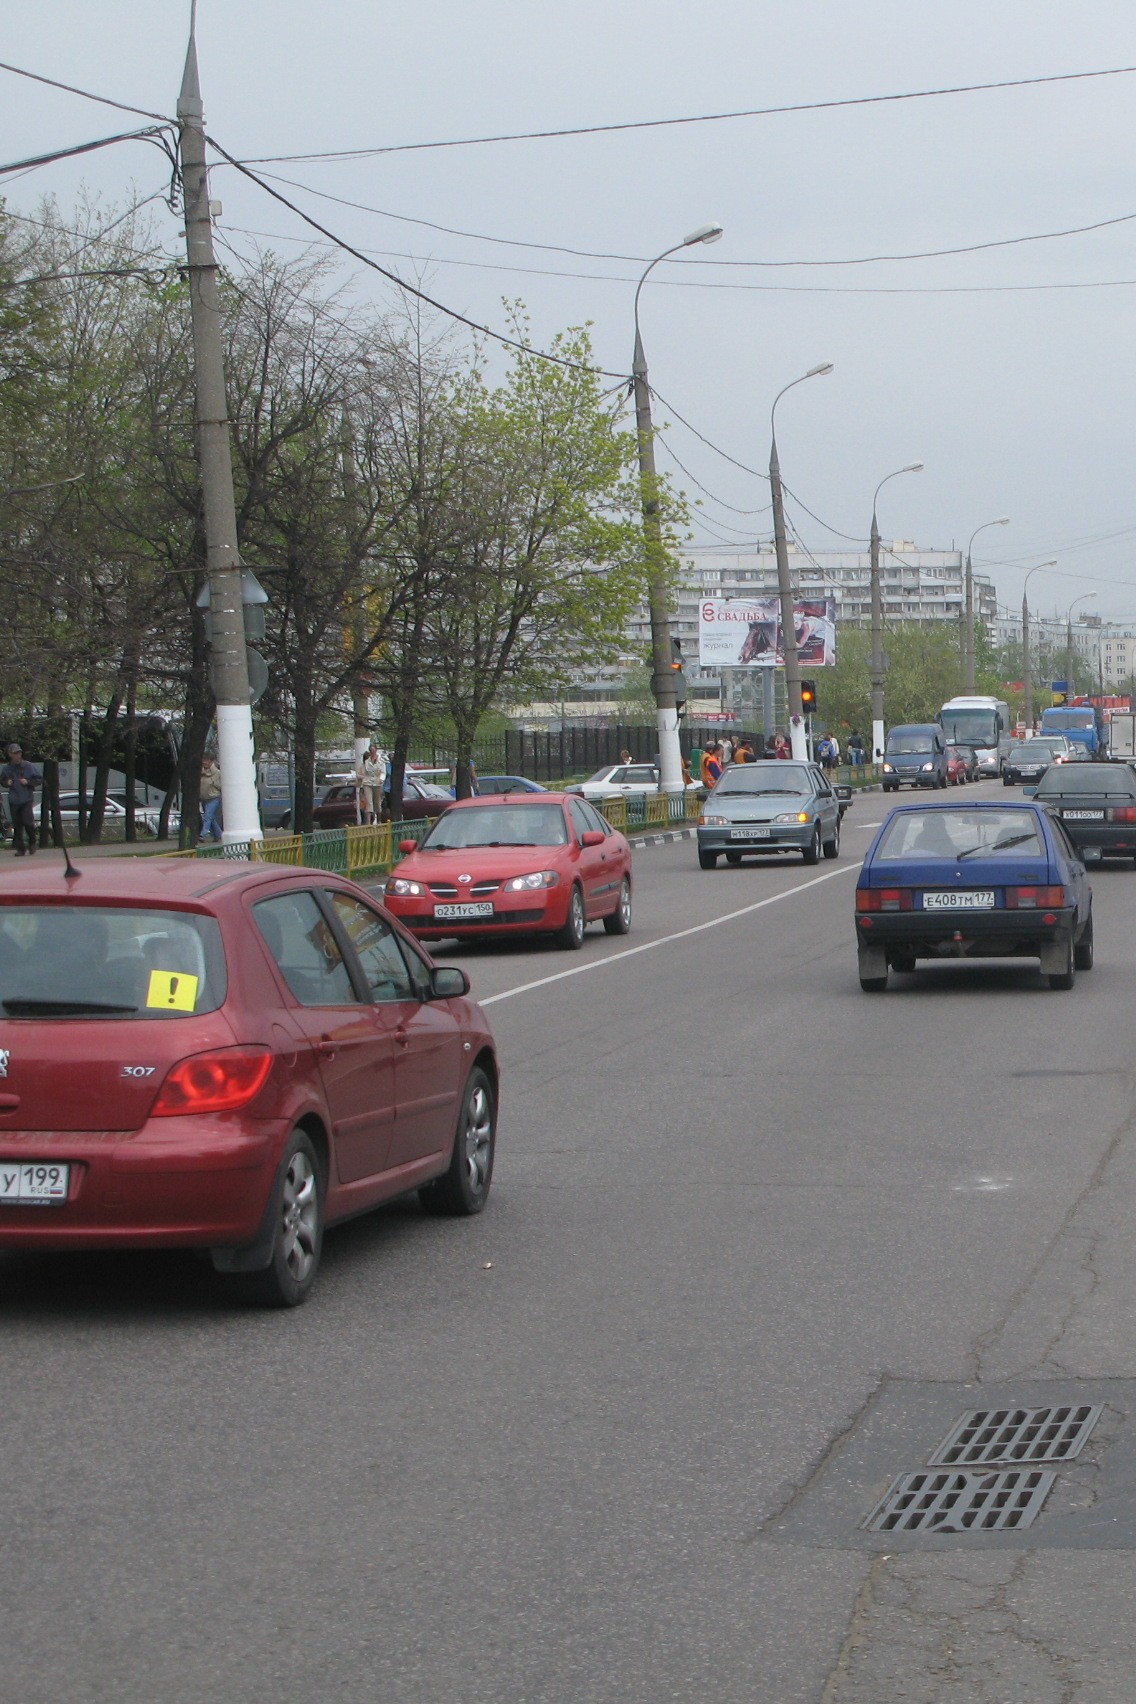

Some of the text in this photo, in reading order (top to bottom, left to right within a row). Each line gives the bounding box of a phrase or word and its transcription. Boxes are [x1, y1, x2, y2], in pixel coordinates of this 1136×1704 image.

[717, 612, 767, 622] СВАДЬБА
[703, 642, 733, 650] журнал
[120, 1066, 156, 1078] 307
[23, 1166, 60, 1187] 199
[31, 1186, 49, 1195] RUS
